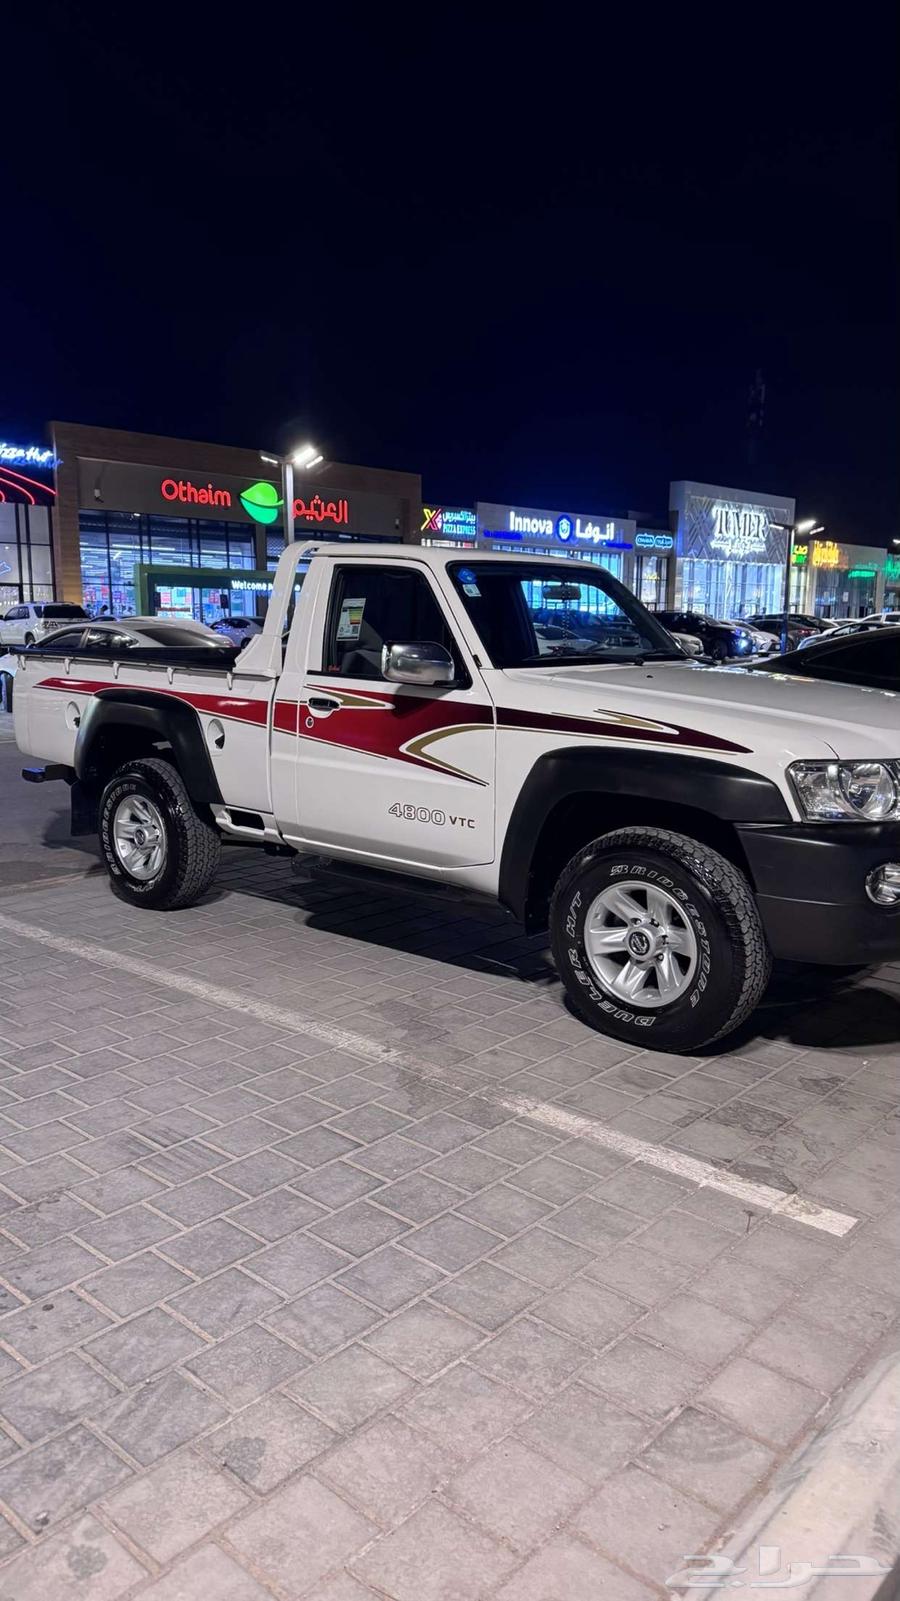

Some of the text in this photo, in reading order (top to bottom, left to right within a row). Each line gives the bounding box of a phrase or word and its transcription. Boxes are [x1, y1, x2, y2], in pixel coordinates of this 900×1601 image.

[161, 479, 232, 507] Othaim
[292, 494, 348, 524] العثيم
[509, 511, 554, 535] Innova
[231, 580, 267, 591] Welcome
[388, 802, 476, 829] 4800 VTC
[609, 864, 711, 1008] BRIDGESTONE
[568, 948, 657, 1027] DUELER
